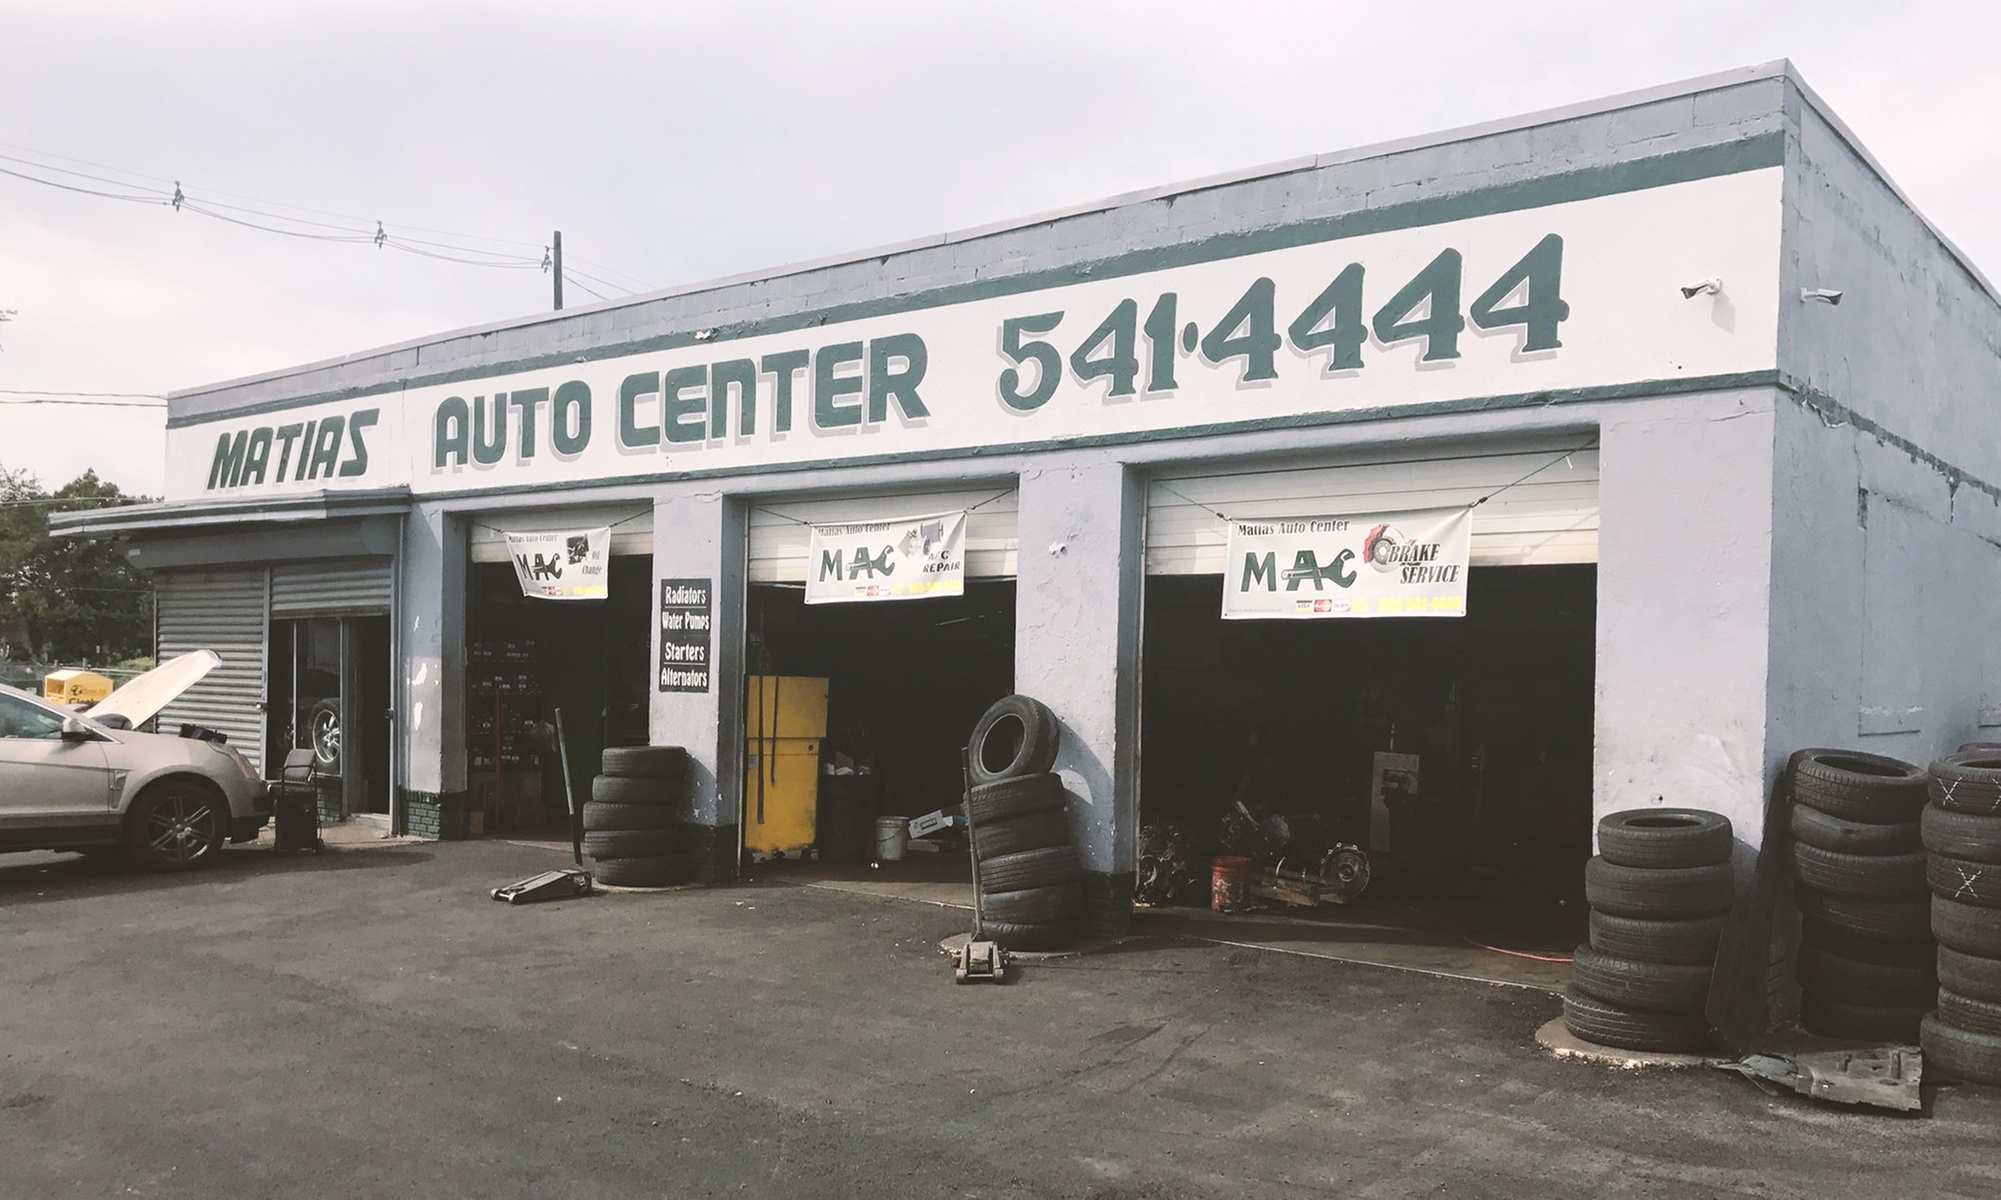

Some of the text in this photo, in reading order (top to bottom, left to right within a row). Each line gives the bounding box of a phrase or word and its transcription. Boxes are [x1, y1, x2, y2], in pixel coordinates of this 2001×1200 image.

[207, 408, 380, 490] MATIAS
[434, 380, 592, 468] AUTO
[619, 332, 931, 447] CENTER
[1237, 519, 1350, 537] Matias Auto Center
[928, 550, 949, 560] A/C
[1388, 543, 1441, 563] BRAKE
[515, 552, 563, 582] MAC
[581, 564, 603, 575] Change
[818, 544, 896, 583] MAC
[923, 561, 961, 573] REPAIR
[1240, 548, 1358, 593] MAC
[1400, 564, 1461, 584] SERVICE
[665, 585, 707, 605] Radiators
[662, 611, 710, 630] Water Pumps
[664, 641, 705, 661] Starters
[661, 667, 708, 688] Alternators
